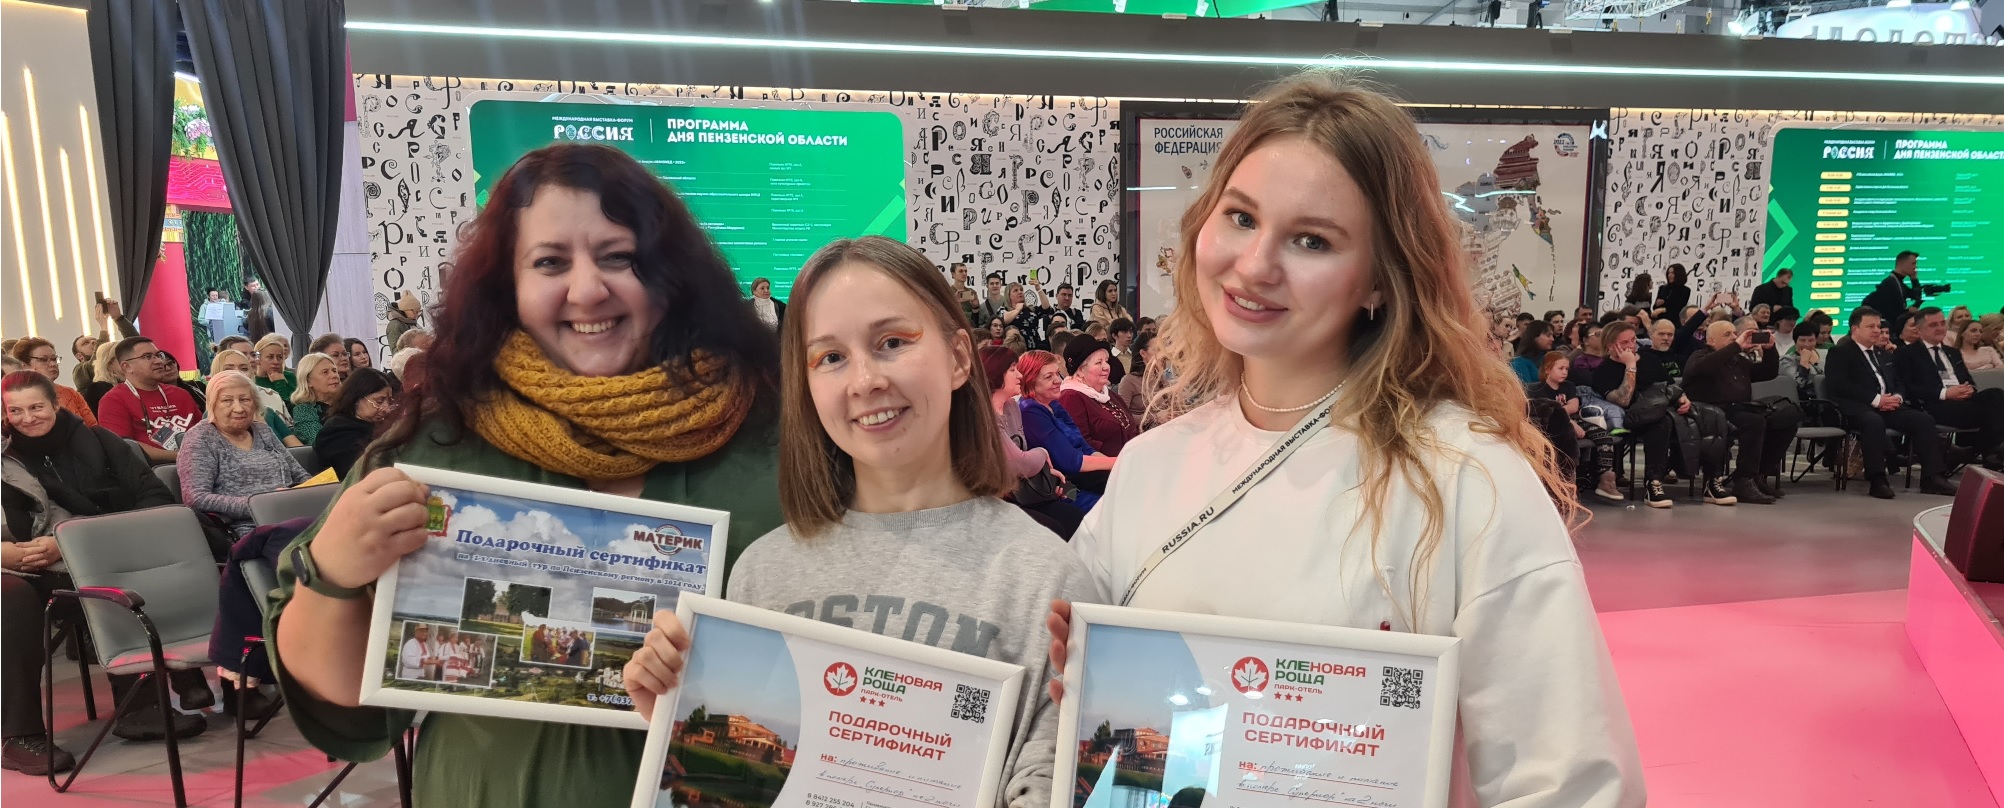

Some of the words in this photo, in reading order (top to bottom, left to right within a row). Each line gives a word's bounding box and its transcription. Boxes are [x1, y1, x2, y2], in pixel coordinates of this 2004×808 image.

[553, 124, 634, 141] РОССИЯ
[667, 118, 749, 132] ПРОГРАММА
[1154, 124, 1223, 139] РОССИЙСКАЯ
[667, 132, 695, 144] ДНЯ
[698, 131, 785, 146] ПЕНЗЕНСКОЙ
[787, 134, 848, 147] ОБЛАСТИ
[1895, 139, 1948, 149] ПРОГРАММА
[1893, 150, 1913, 159] ДНЯ
[1913, 148, 1970, 160] ПЕНЗЕНСКОЙ
[1232, 444, 1286, 494] МЕЖДУНАРОДНАЯ
[1161, 506, 1215, 554] RUSSIA.RU
[633, 530, 703, 550] МАТЕРИК
[455, 529, 585, 559] Подарочный
[590, 549, 706, 575] сертификат
[532, 562, 548, 571] тур
[562, 565, 620, 580] Пензенскому
[620, 573, 657, 584] региону
[665, 579, 681, 587] 2024
[1275, 658, 1367, 678] КЛЕНОВАЯ
[862, 677, 906, 695] РОЩА
[864, 666, 943, 692] КЛЕНОВАЯ
[1275, 670, 1325, 686] РОЩА
[860, 688, 903, 702] ПАРК-ОТЕЛЬ
[1274, 683, 1323, 694] ПАРК-ОТЕЛЬ
[828, 710, 952, 747] ПОДАРОЧНЫЙ
[1242, 711, 1386, 741] ПОДАРОЧНЫЙ
[829, 726, 946, 761] СЕРТИФИКАТ
[1244, 729, 1380, 757] СЕРТИФИКАТ
[820, 753, 837, 763] на:
[1238, 760, 1258, 770] на:
